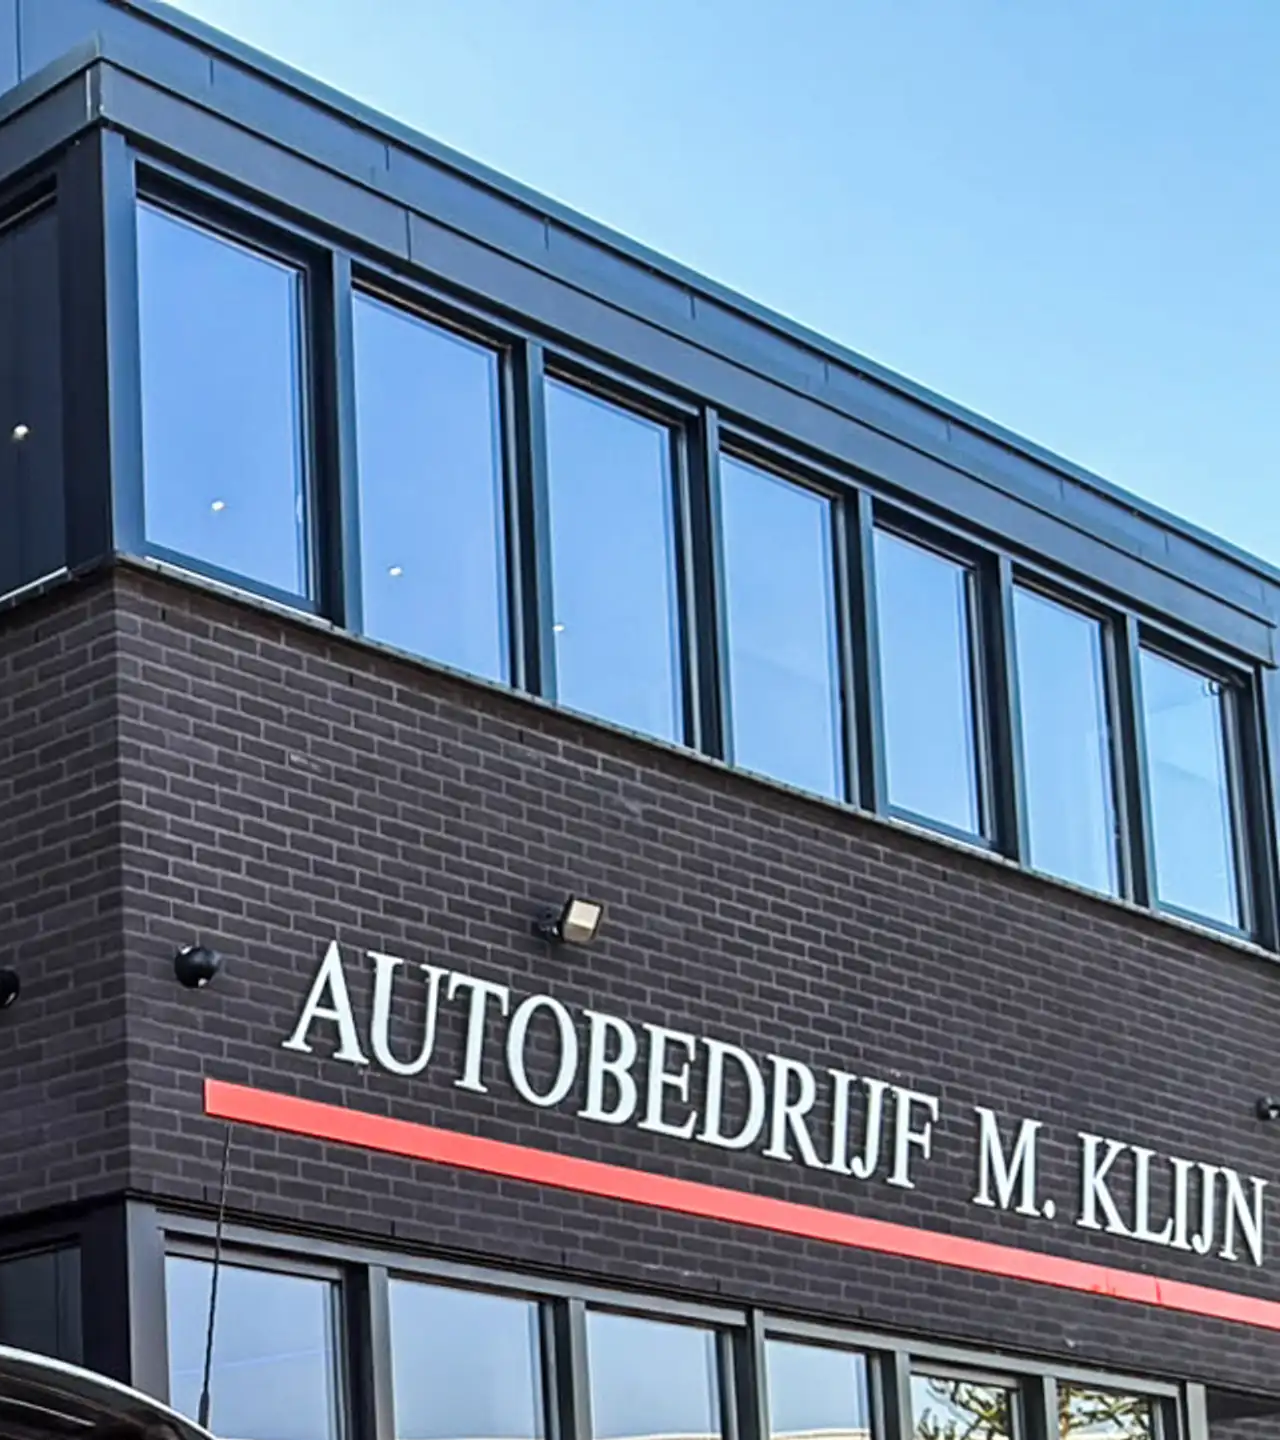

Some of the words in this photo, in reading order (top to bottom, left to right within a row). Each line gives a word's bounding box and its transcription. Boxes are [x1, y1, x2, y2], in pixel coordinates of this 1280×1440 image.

[280, 940, 941, 1190] AUTOBEDRIJF
[970, 1105, 1059, 1222] M.
[1075, 1131, 1268, 1268] KLIJN
